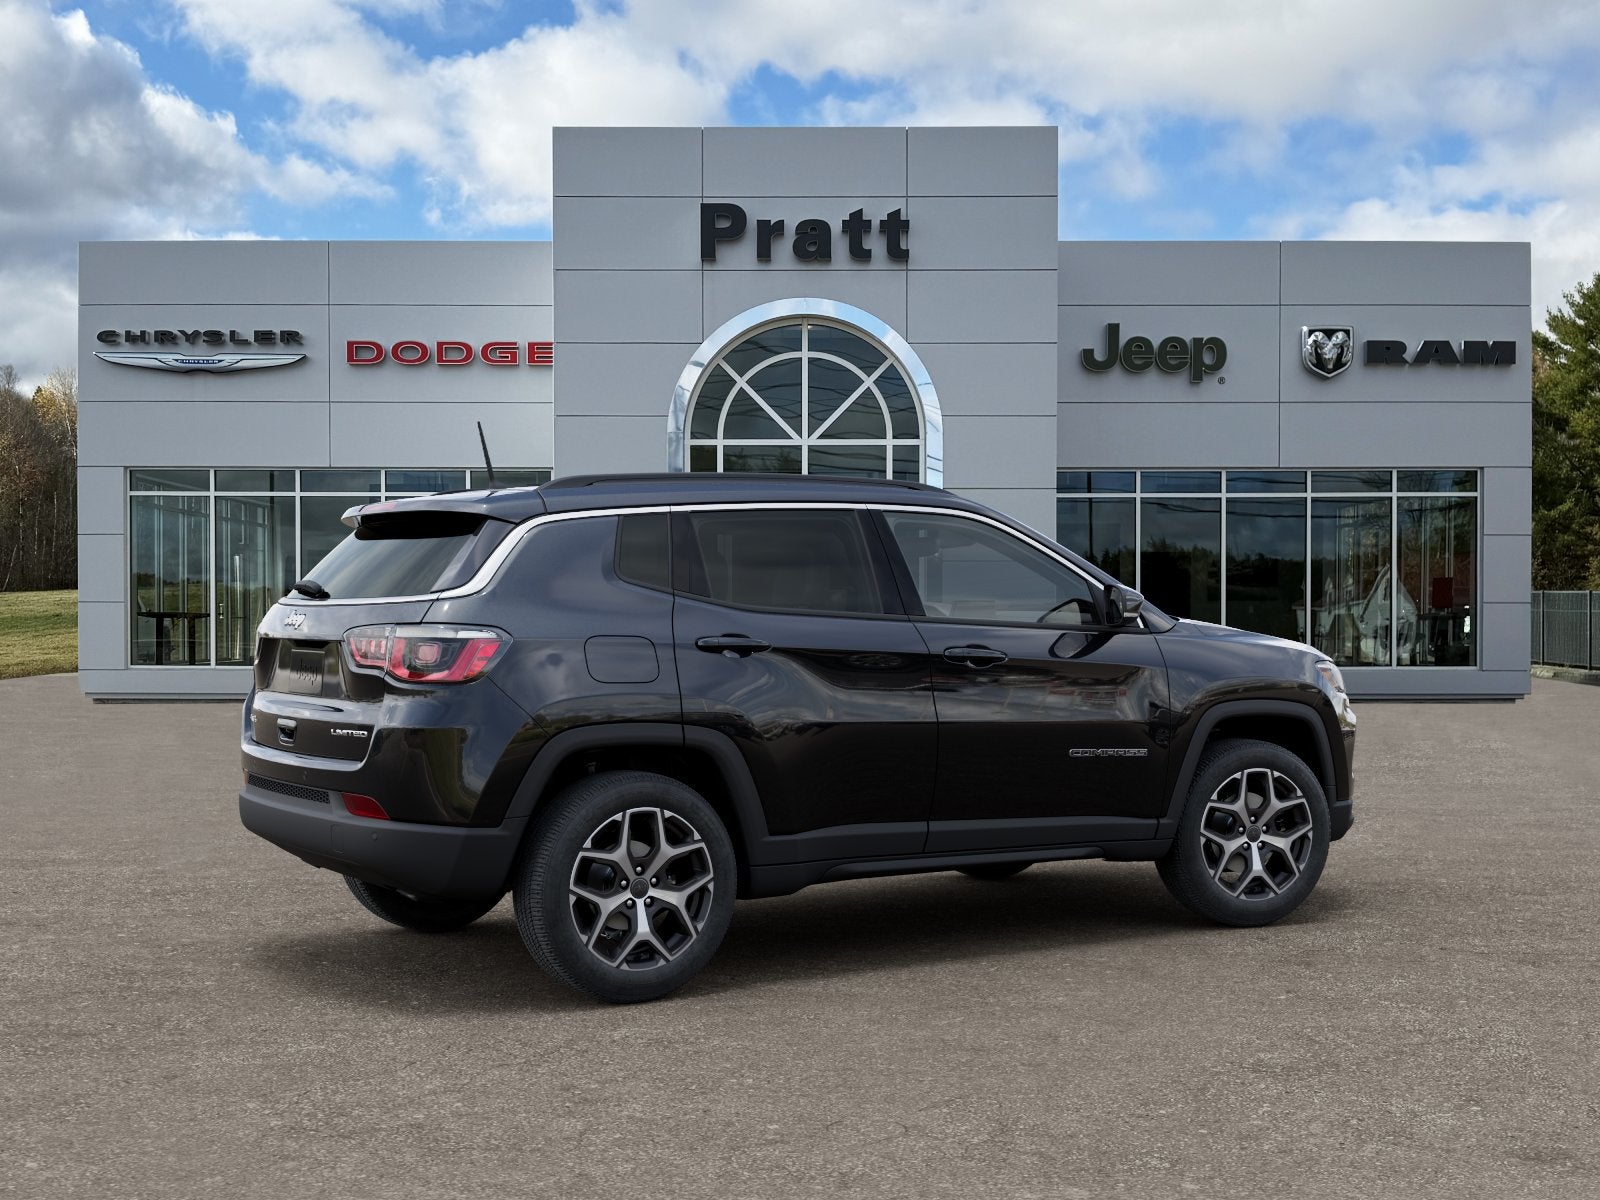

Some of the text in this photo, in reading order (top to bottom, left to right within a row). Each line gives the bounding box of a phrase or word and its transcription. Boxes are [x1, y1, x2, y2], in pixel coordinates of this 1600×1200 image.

[700, 202, 910, 262] Pratt
[97, 329, 303, 345] CHRYSLER
[346, 340, 554, 365] DODGE
[1081, 322, 1228, 383] Jeep
[1364, 340, 1517, 365] RAM
[330, 728, 368, 738] LIMITED
[1069, 748, 1148, 757] COMPASS
